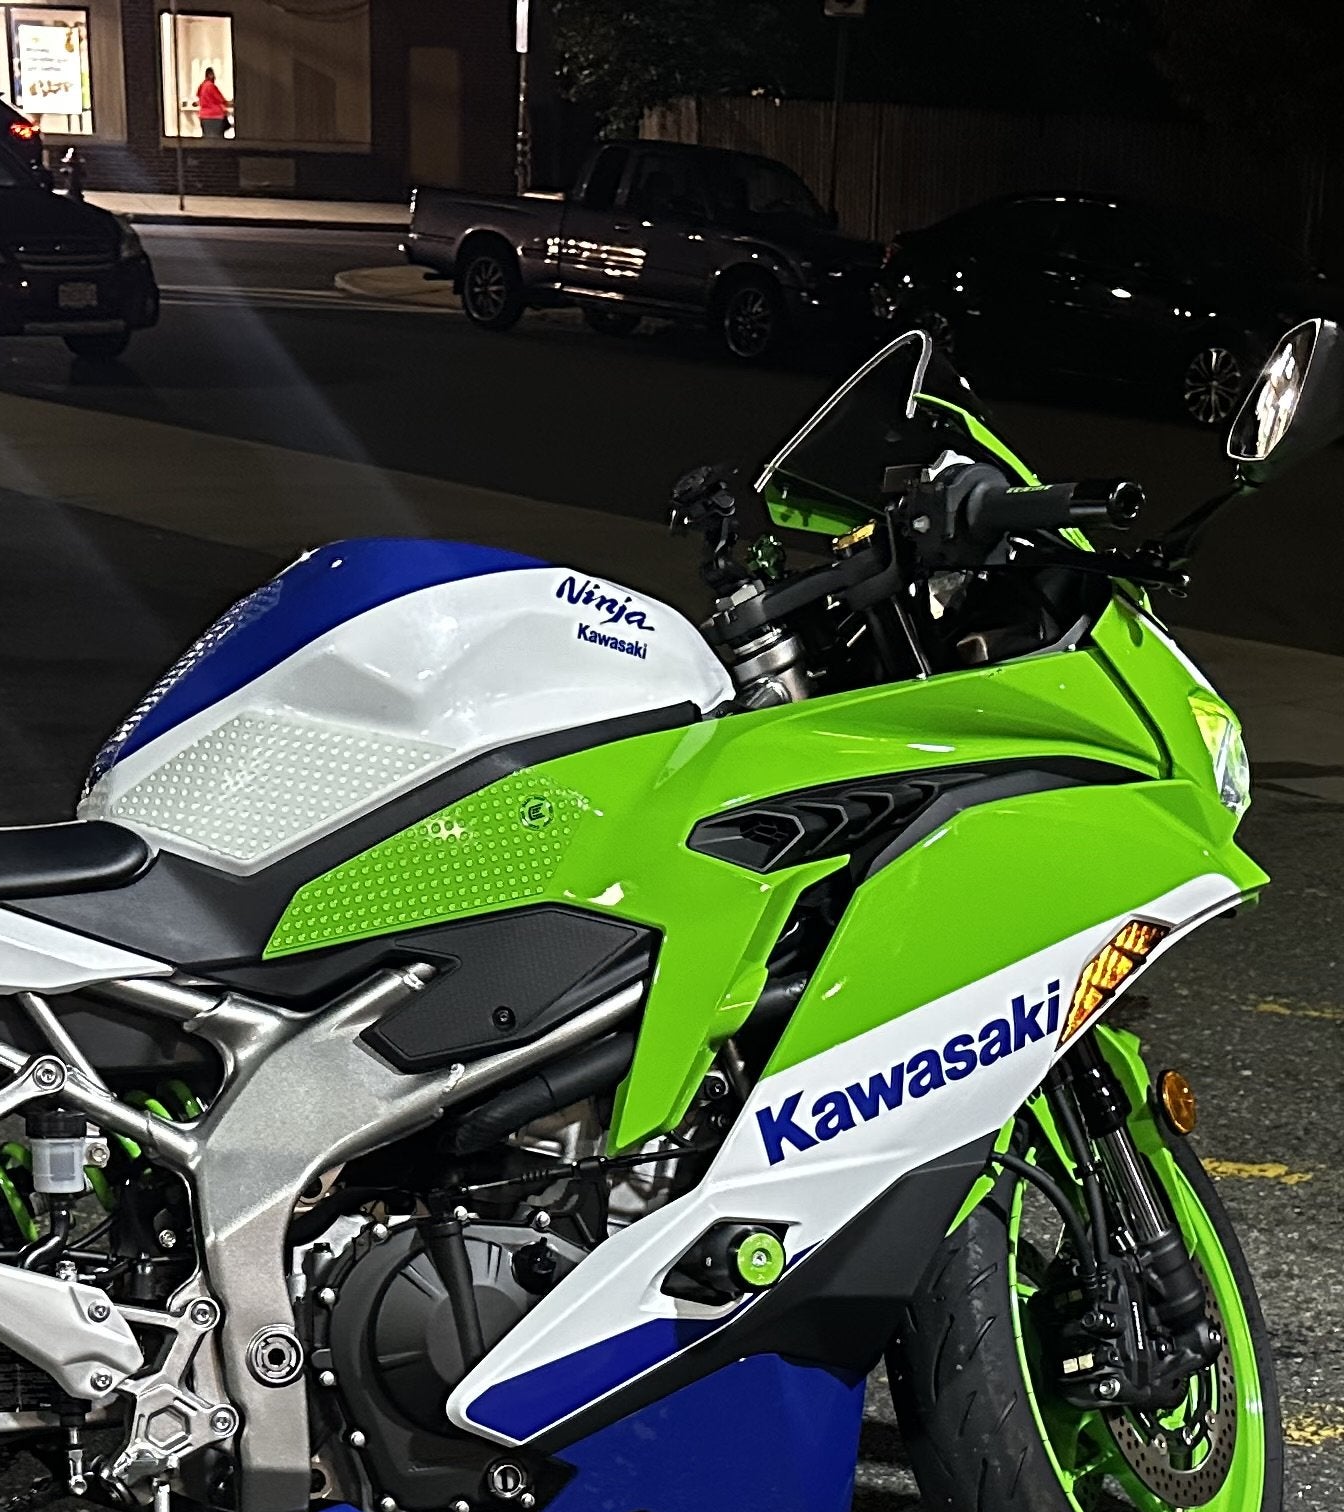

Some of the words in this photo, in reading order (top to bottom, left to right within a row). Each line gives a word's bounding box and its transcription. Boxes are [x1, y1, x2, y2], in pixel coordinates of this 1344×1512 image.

[556, 576, 655, 631] Ninja
[577, 623, 647, 659] Kawasaki
[755, 979, 1060, 1166] Kawasaki
